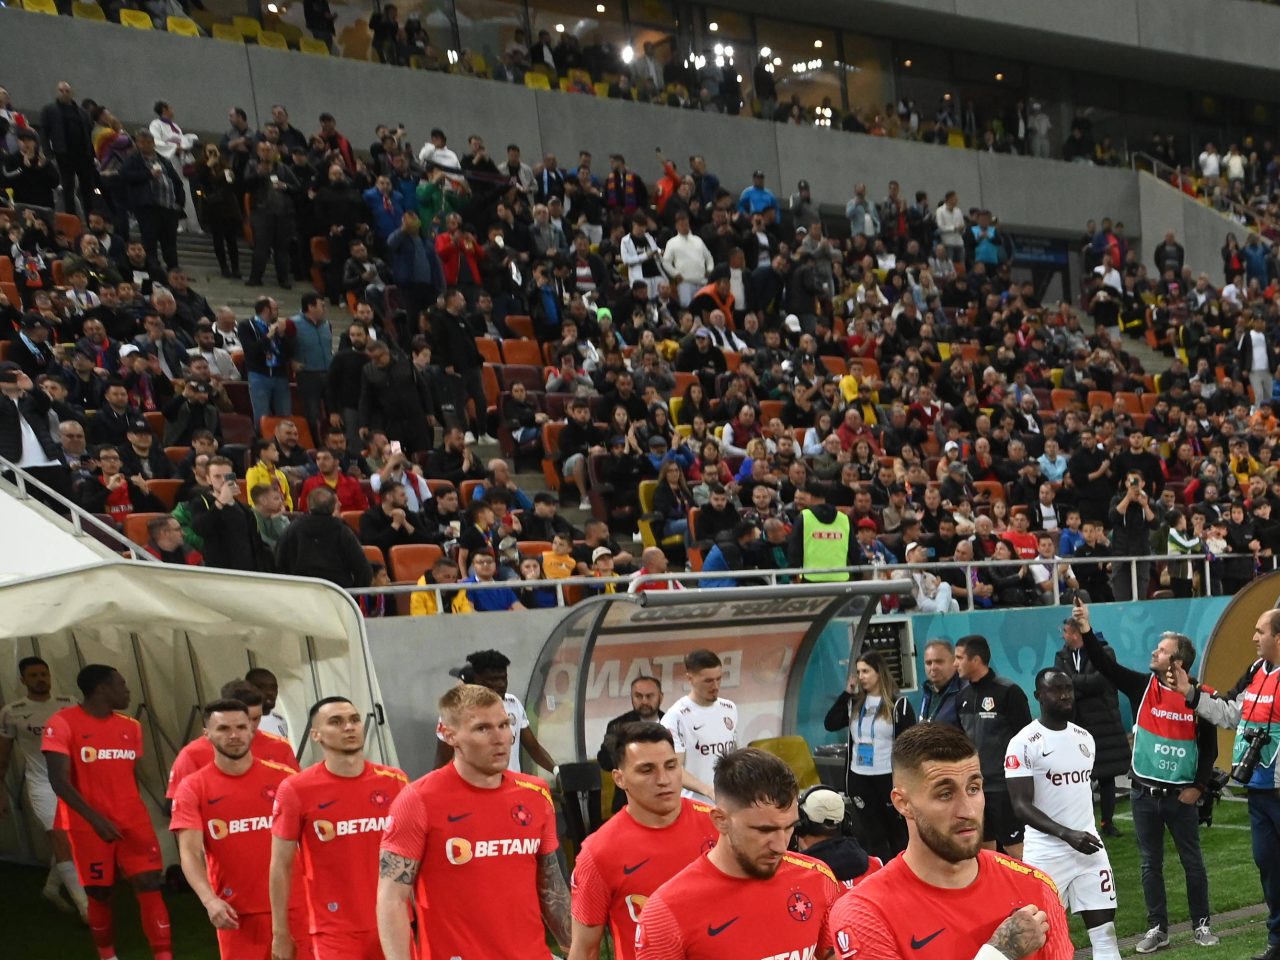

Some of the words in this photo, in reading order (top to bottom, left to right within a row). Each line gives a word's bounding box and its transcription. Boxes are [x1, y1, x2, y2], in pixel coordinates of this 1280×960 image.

[1151, 707, 1194, 722] SUPERLIG
[97, 748, 136, 761] BETANO
[1154, 743, 1186, 758] FOTO
[1158, 759, 1177, 771] 313
[336, 816, 390, 836] BETAN
[90, 862, 104, 880] 5
